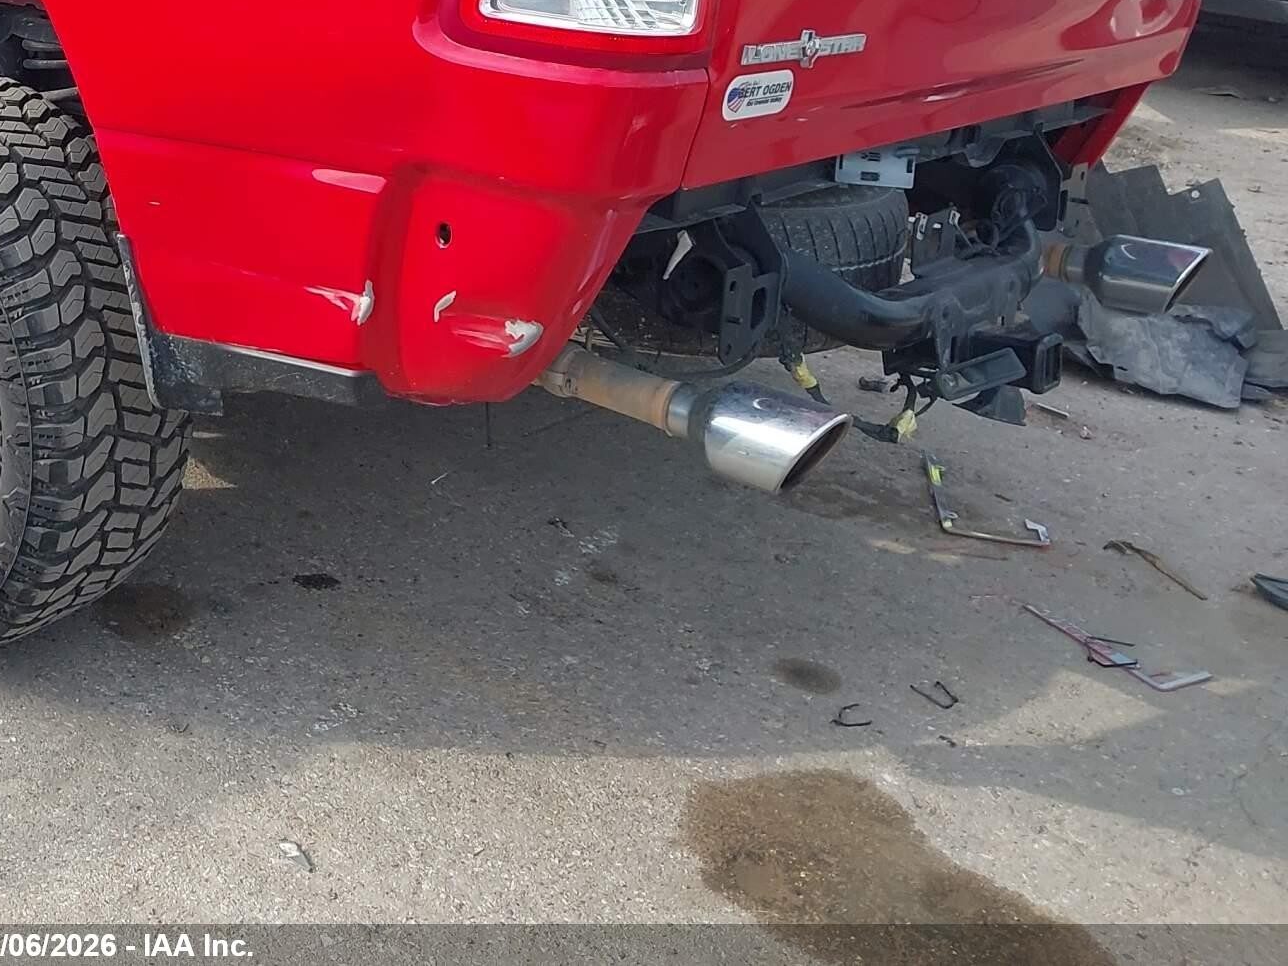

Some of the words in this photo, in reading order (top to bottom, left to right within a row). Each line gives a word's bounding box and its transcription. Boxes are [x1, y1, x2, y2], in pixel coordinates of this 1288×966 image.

[750, 42, 799, 62] LONE
[821, 36, 862, 55] STAR
[762, 80, 792, 95] OGDEN
